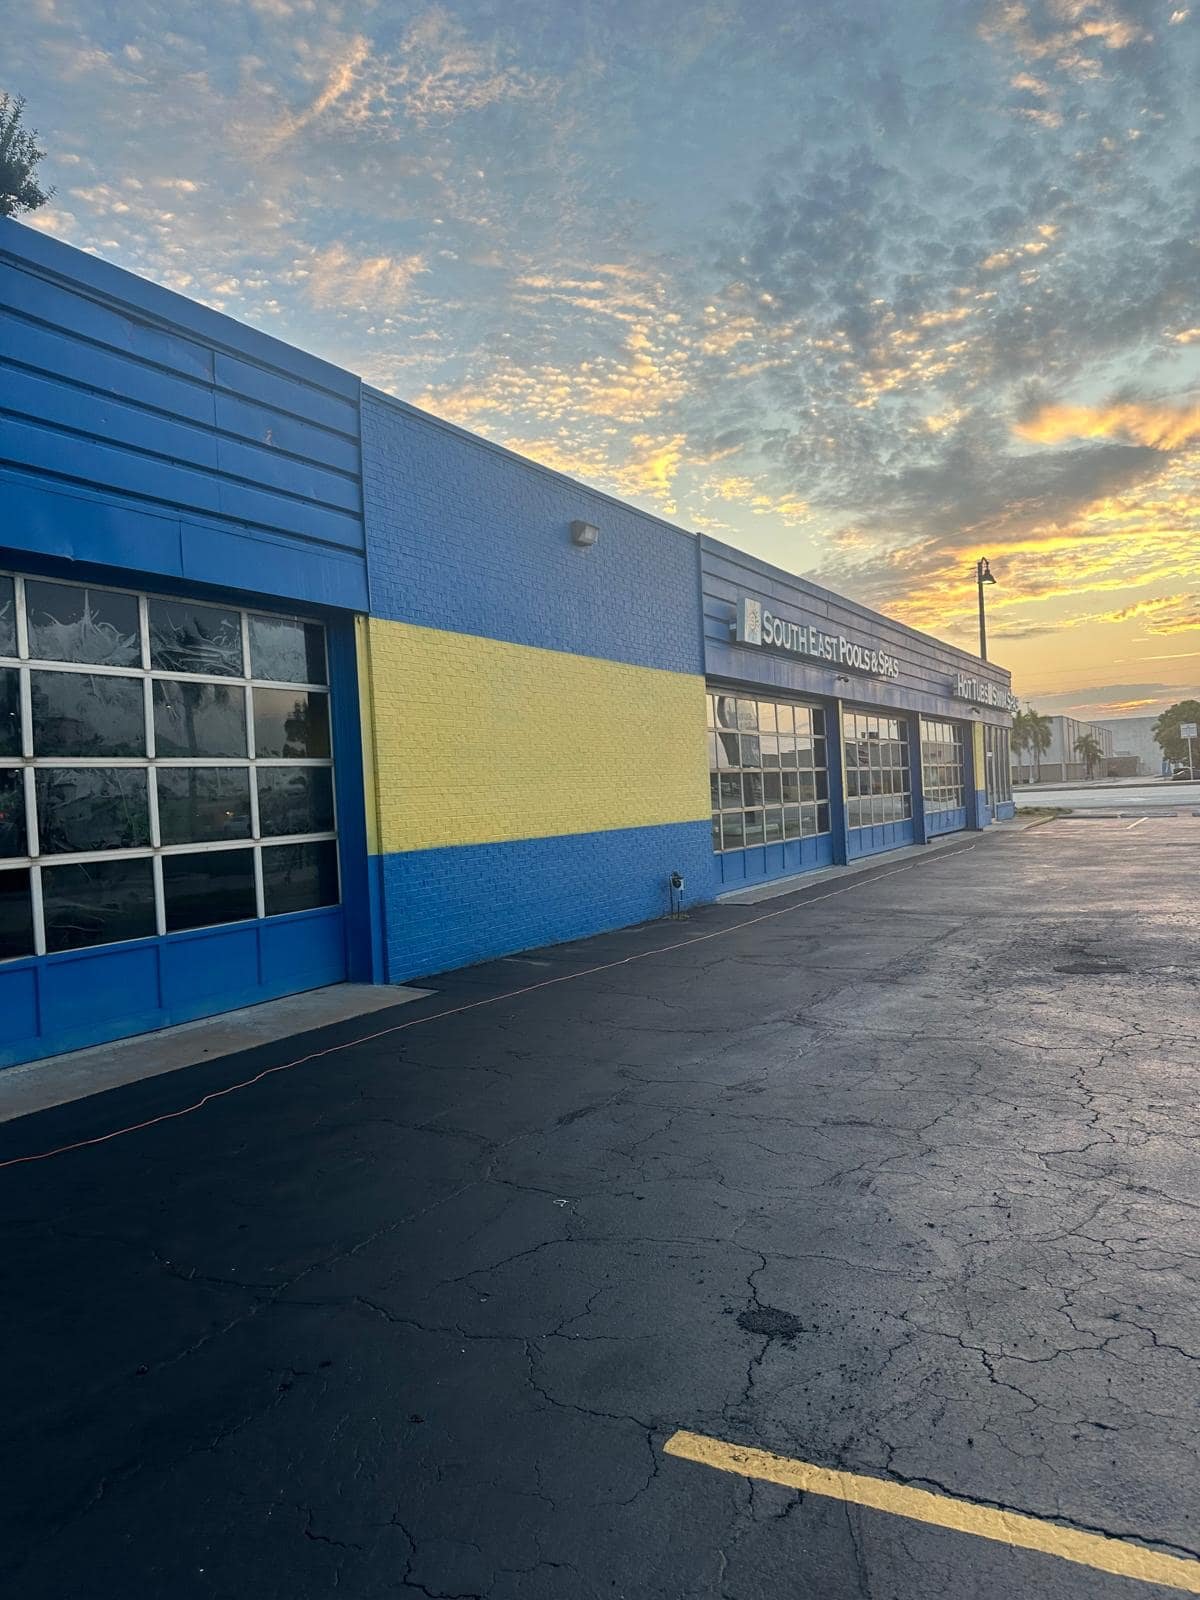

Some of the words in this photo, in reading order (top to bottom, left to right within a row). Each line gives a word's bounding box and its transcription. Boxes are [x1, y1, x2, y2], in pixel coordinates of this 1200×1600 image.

[839, 636, 870, 670] POOLS
[871, 652, 878, 673] &
[878, 650, 899, 678] SPAS
[958, 673, 972, 699] HOT
